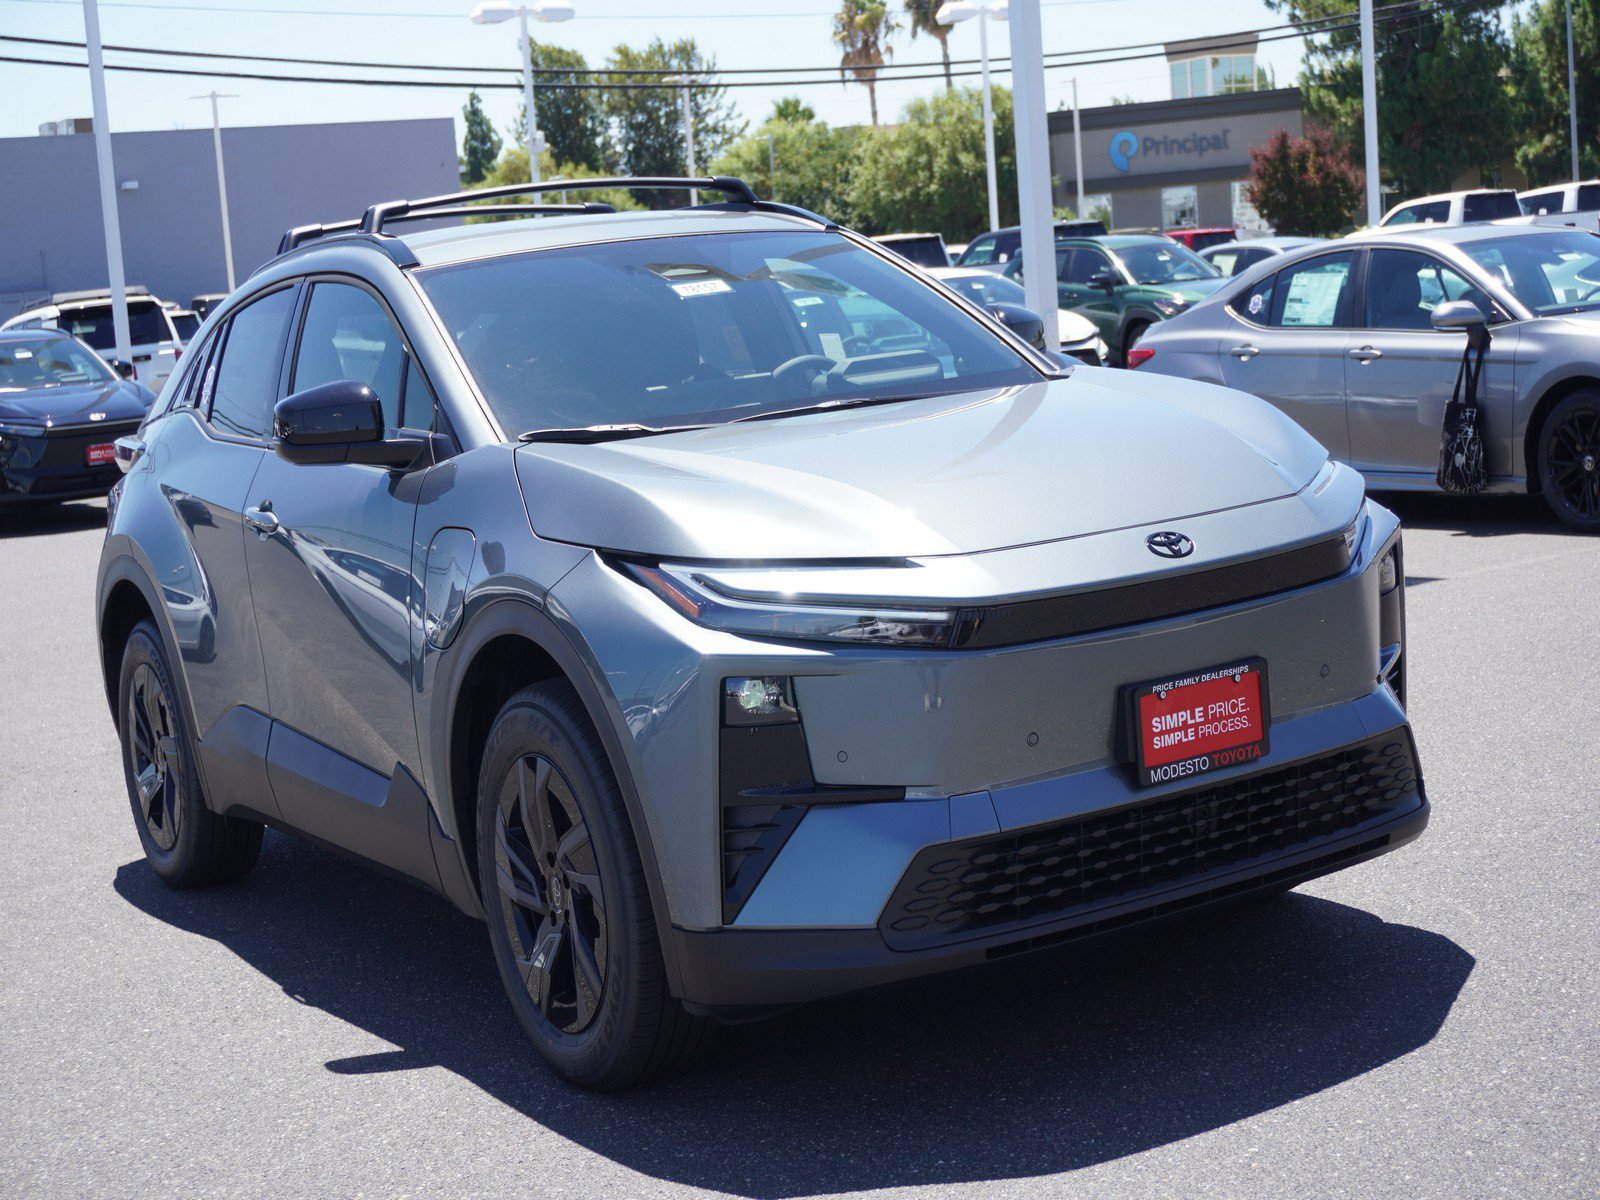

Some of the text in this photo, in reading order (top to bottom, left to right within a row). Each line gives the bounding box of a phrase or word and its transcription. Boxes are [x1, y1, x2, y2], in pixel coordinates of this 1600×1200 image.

[1142, 129, 1230, 157] Principal
[680, 282, 717, 295] 78157
[1152, 666, 1249, 693] PRICE FAMILY DEALERSHIPS
[1151, 697, 1250, 733] SIMPLE PRICE.
[1153, 715, 1251, 749] SIMPLE PROCESS.
[1150, 744, 1261, 783] MODESTO TOYOTA
